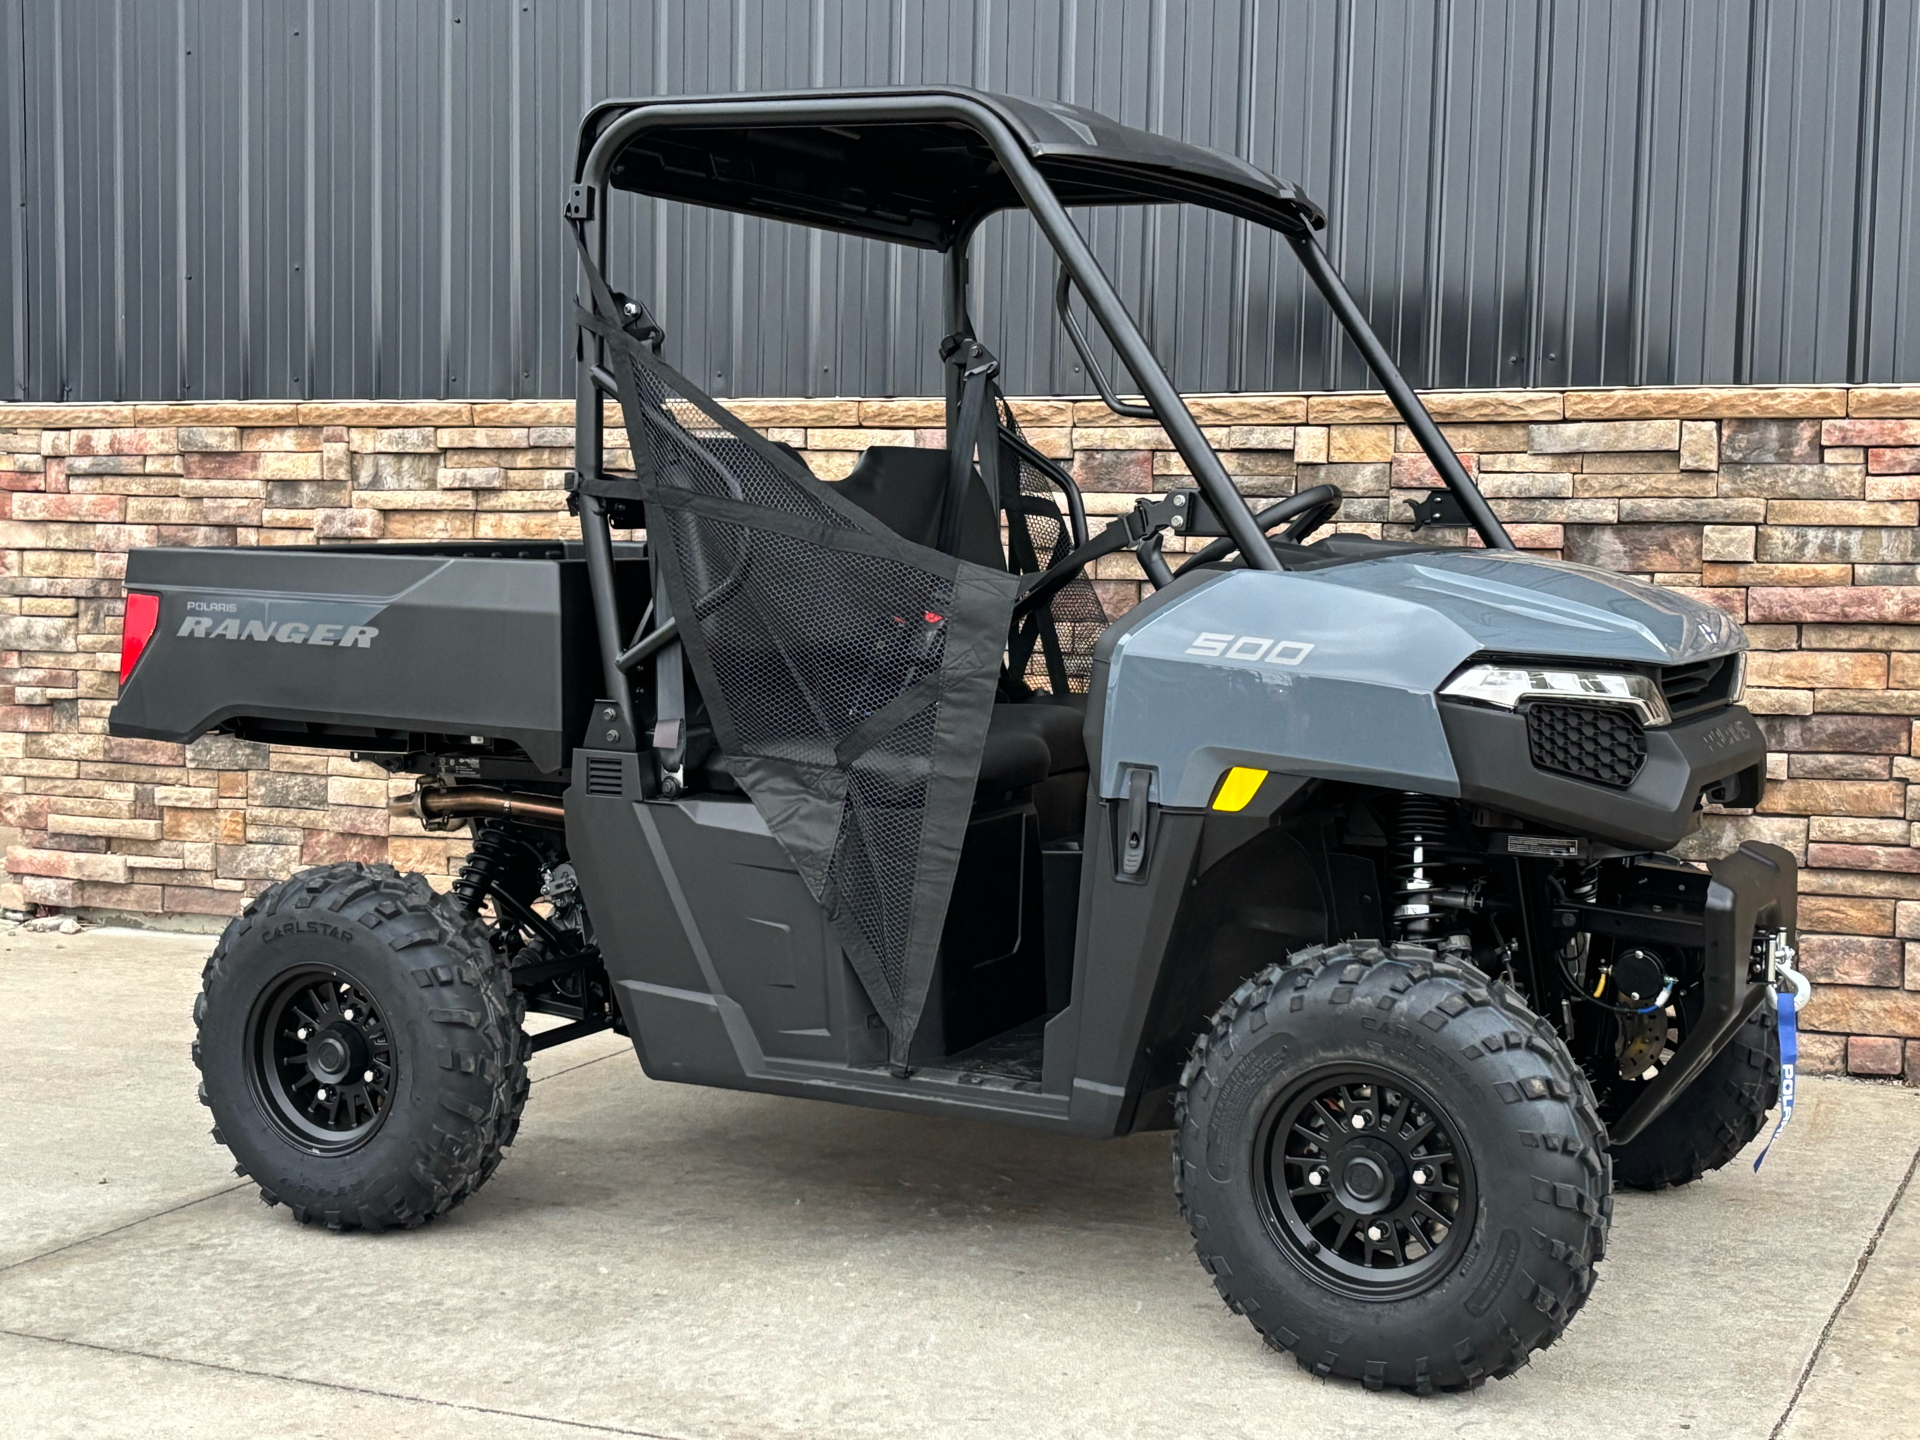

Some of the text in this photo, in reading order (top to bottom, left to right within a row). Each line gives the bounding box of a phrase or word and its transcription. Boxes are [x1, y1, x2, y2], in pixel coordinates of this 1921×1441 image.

[187, 601, 237, 612] POLARIS
[176, 616, 379, 648] RANGER
[1184, 632, 1315, 665] 500
[262, 921, 353, 943] CARLSTAR
